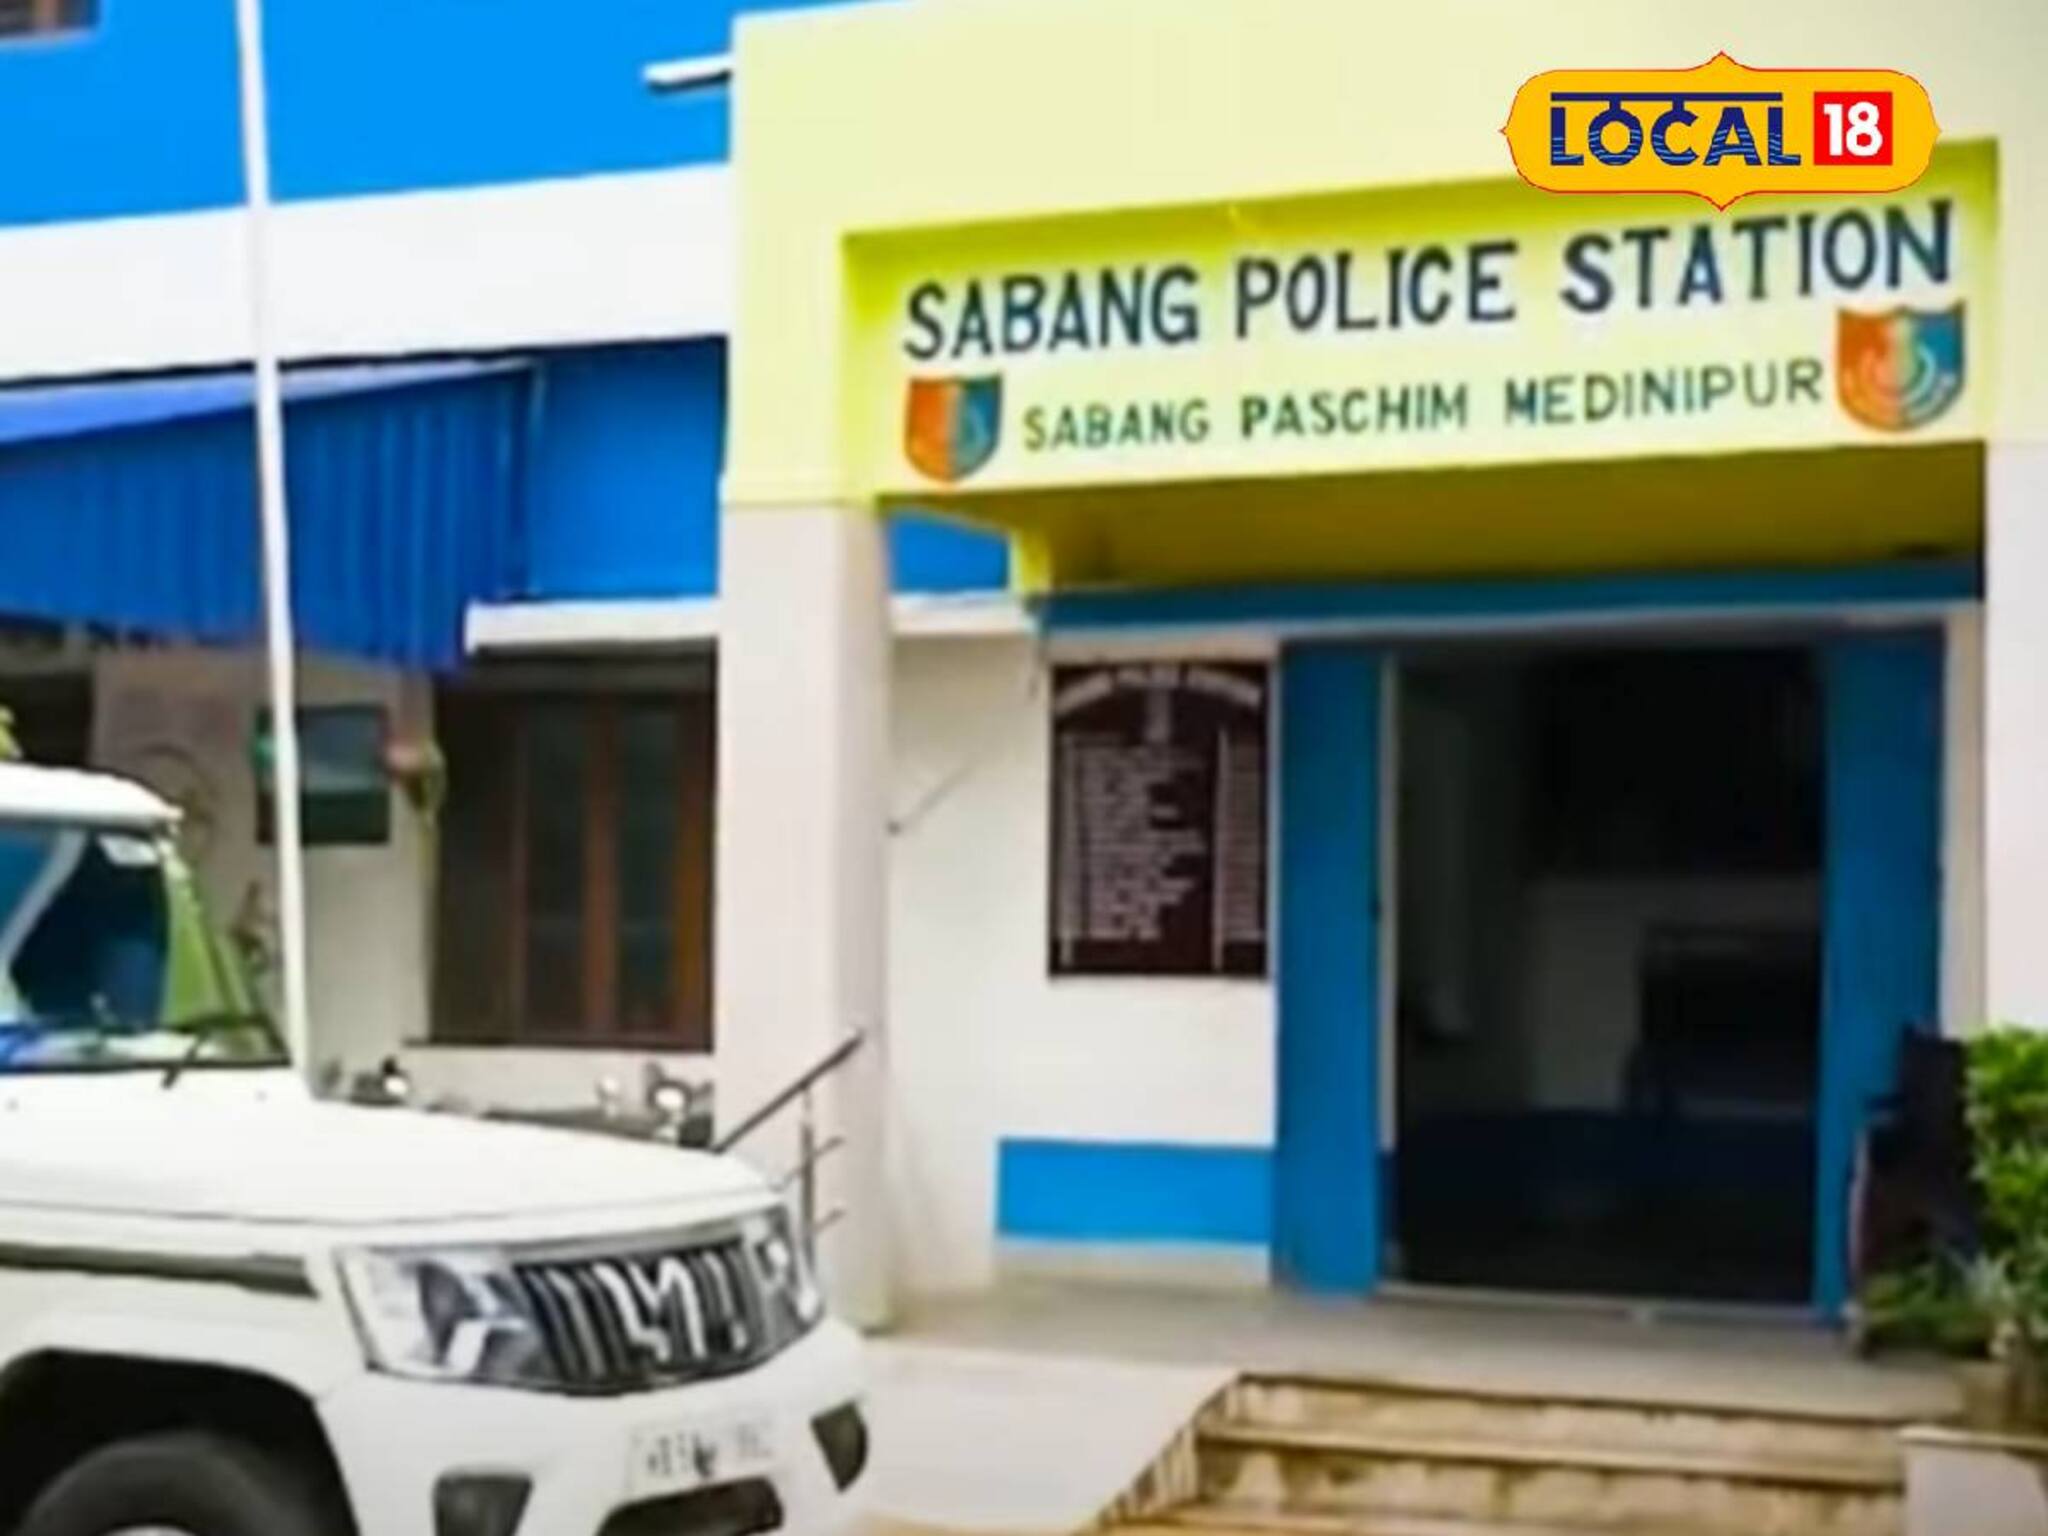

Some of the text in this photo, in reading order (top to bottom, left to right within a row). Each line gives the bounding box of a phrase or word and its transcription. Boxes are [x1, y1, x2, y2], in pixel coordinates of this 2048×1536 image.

[904, 199, 1956, 361] SABANG POLICE STATION
[1022, 357, 1824, 452] SABANG PASCHIM MEDINIPUR
